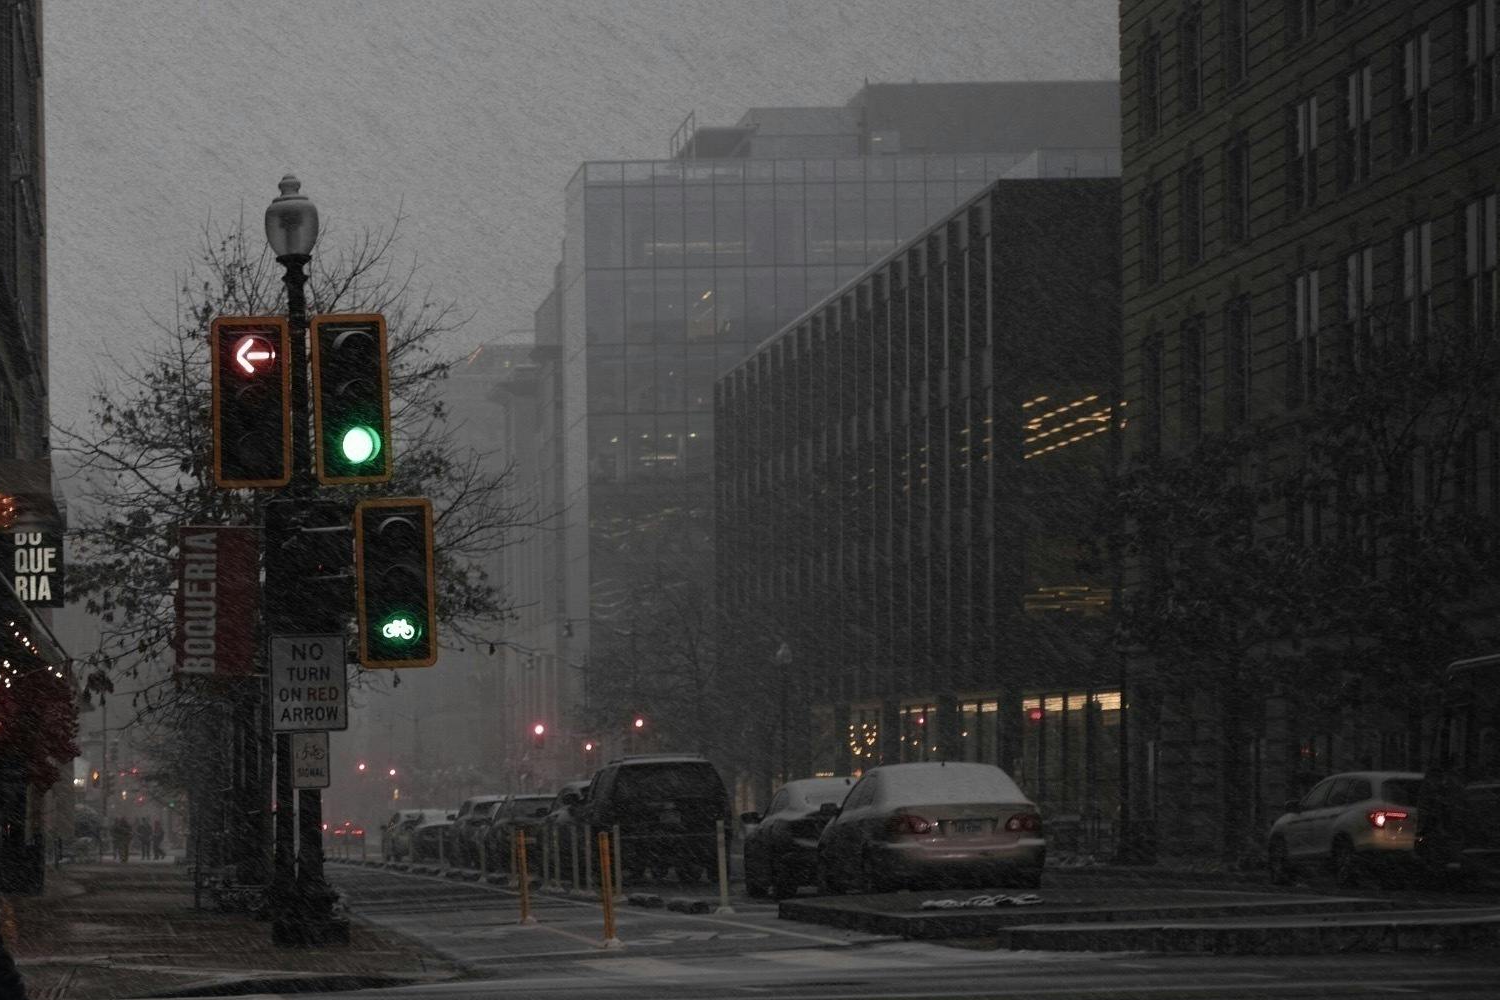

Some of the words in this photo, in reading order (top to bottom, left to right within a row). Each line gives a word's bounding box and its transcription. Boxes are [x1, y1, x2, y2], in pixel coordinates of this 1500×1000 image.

[14, 548, 56, 574] QUE
[14, 575, 52, 601] RIA
[183, 532, 217, 673] BOQUERIA
[291, 643, 323, 661] NO
[286, 667, 330, 681] TURN
[279, 687, 301, 702] ON
[307, 686, 339, 702] RED
[280, 706, 339, 722] ARROW
[296, 768, 325, 778] SIGNAL
